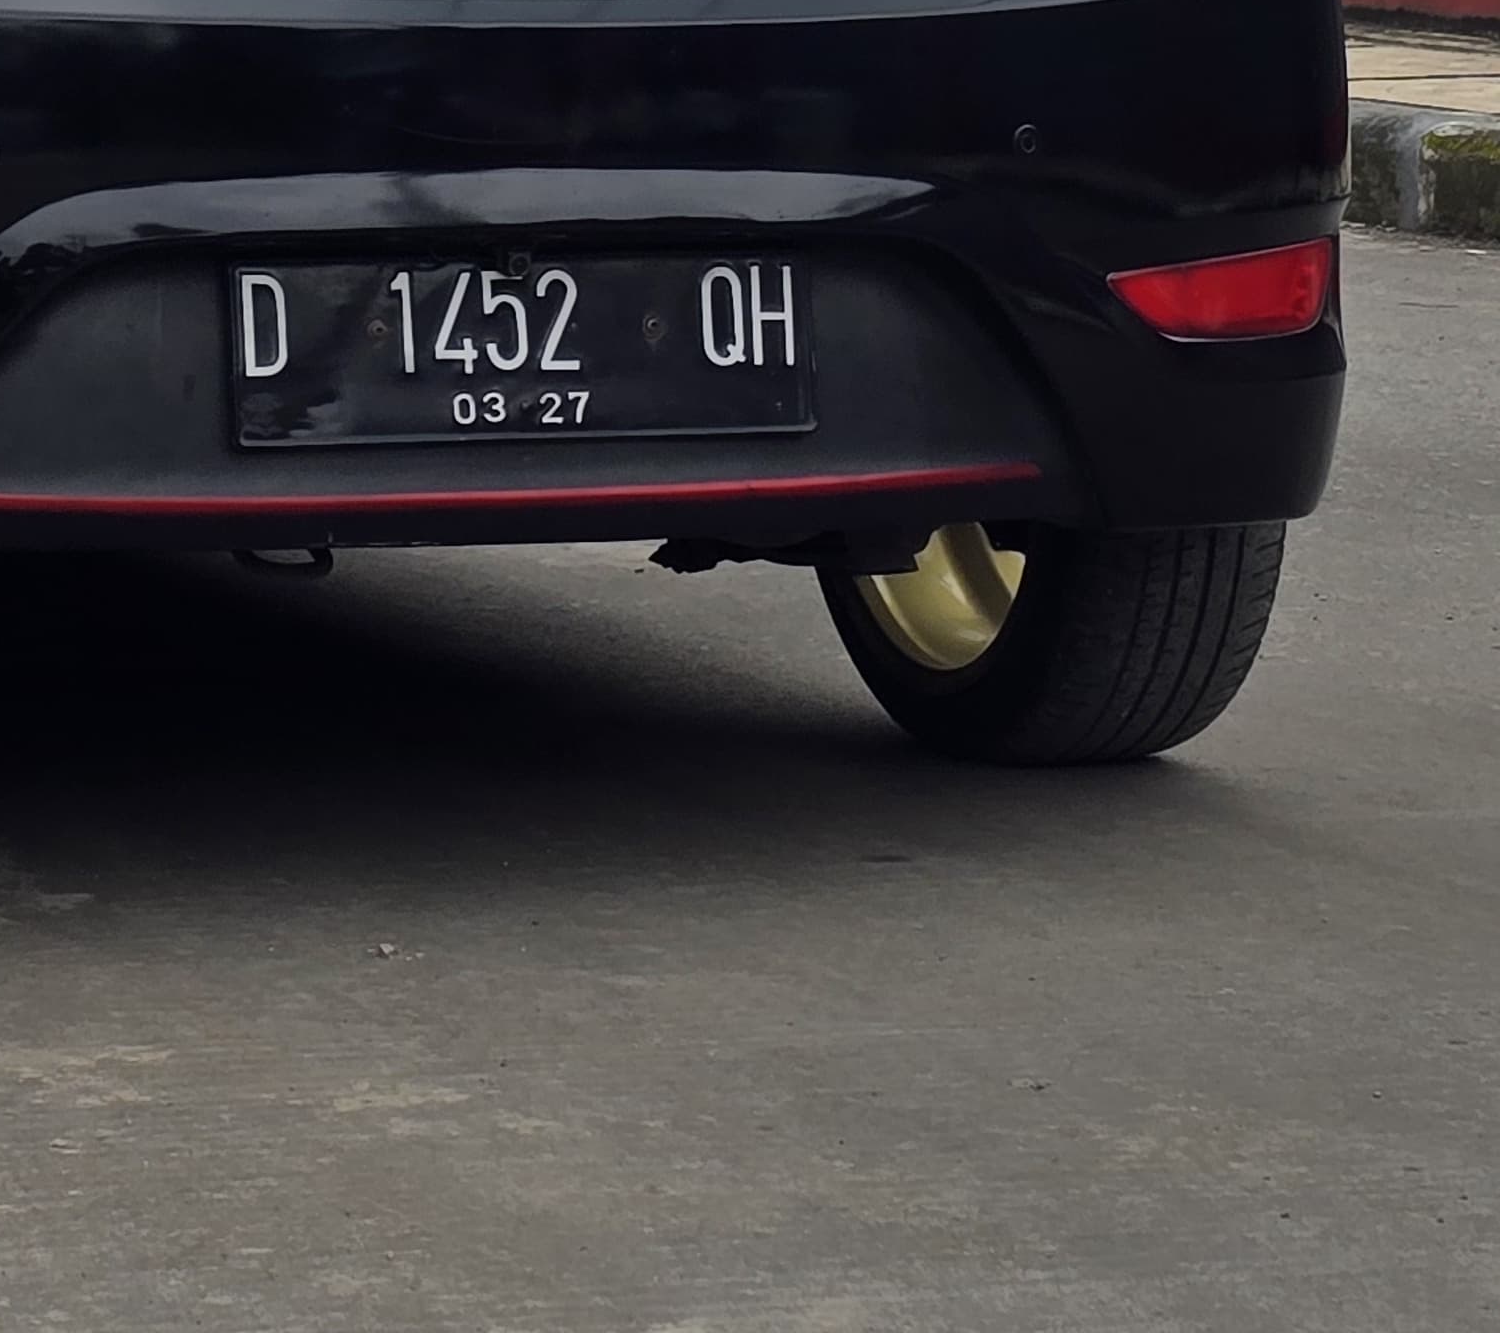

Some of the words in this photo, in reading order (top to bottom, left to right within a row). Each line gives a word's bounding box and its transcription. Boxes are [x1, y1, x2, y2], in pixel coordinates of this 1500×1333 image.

[240, 273, 289, 377] D
[389, 268, 582, 375] 1452
[701, 265, 796, 367] QH
[452, 392, 507, 425] 03
[538, 390, 591, 425] 27
